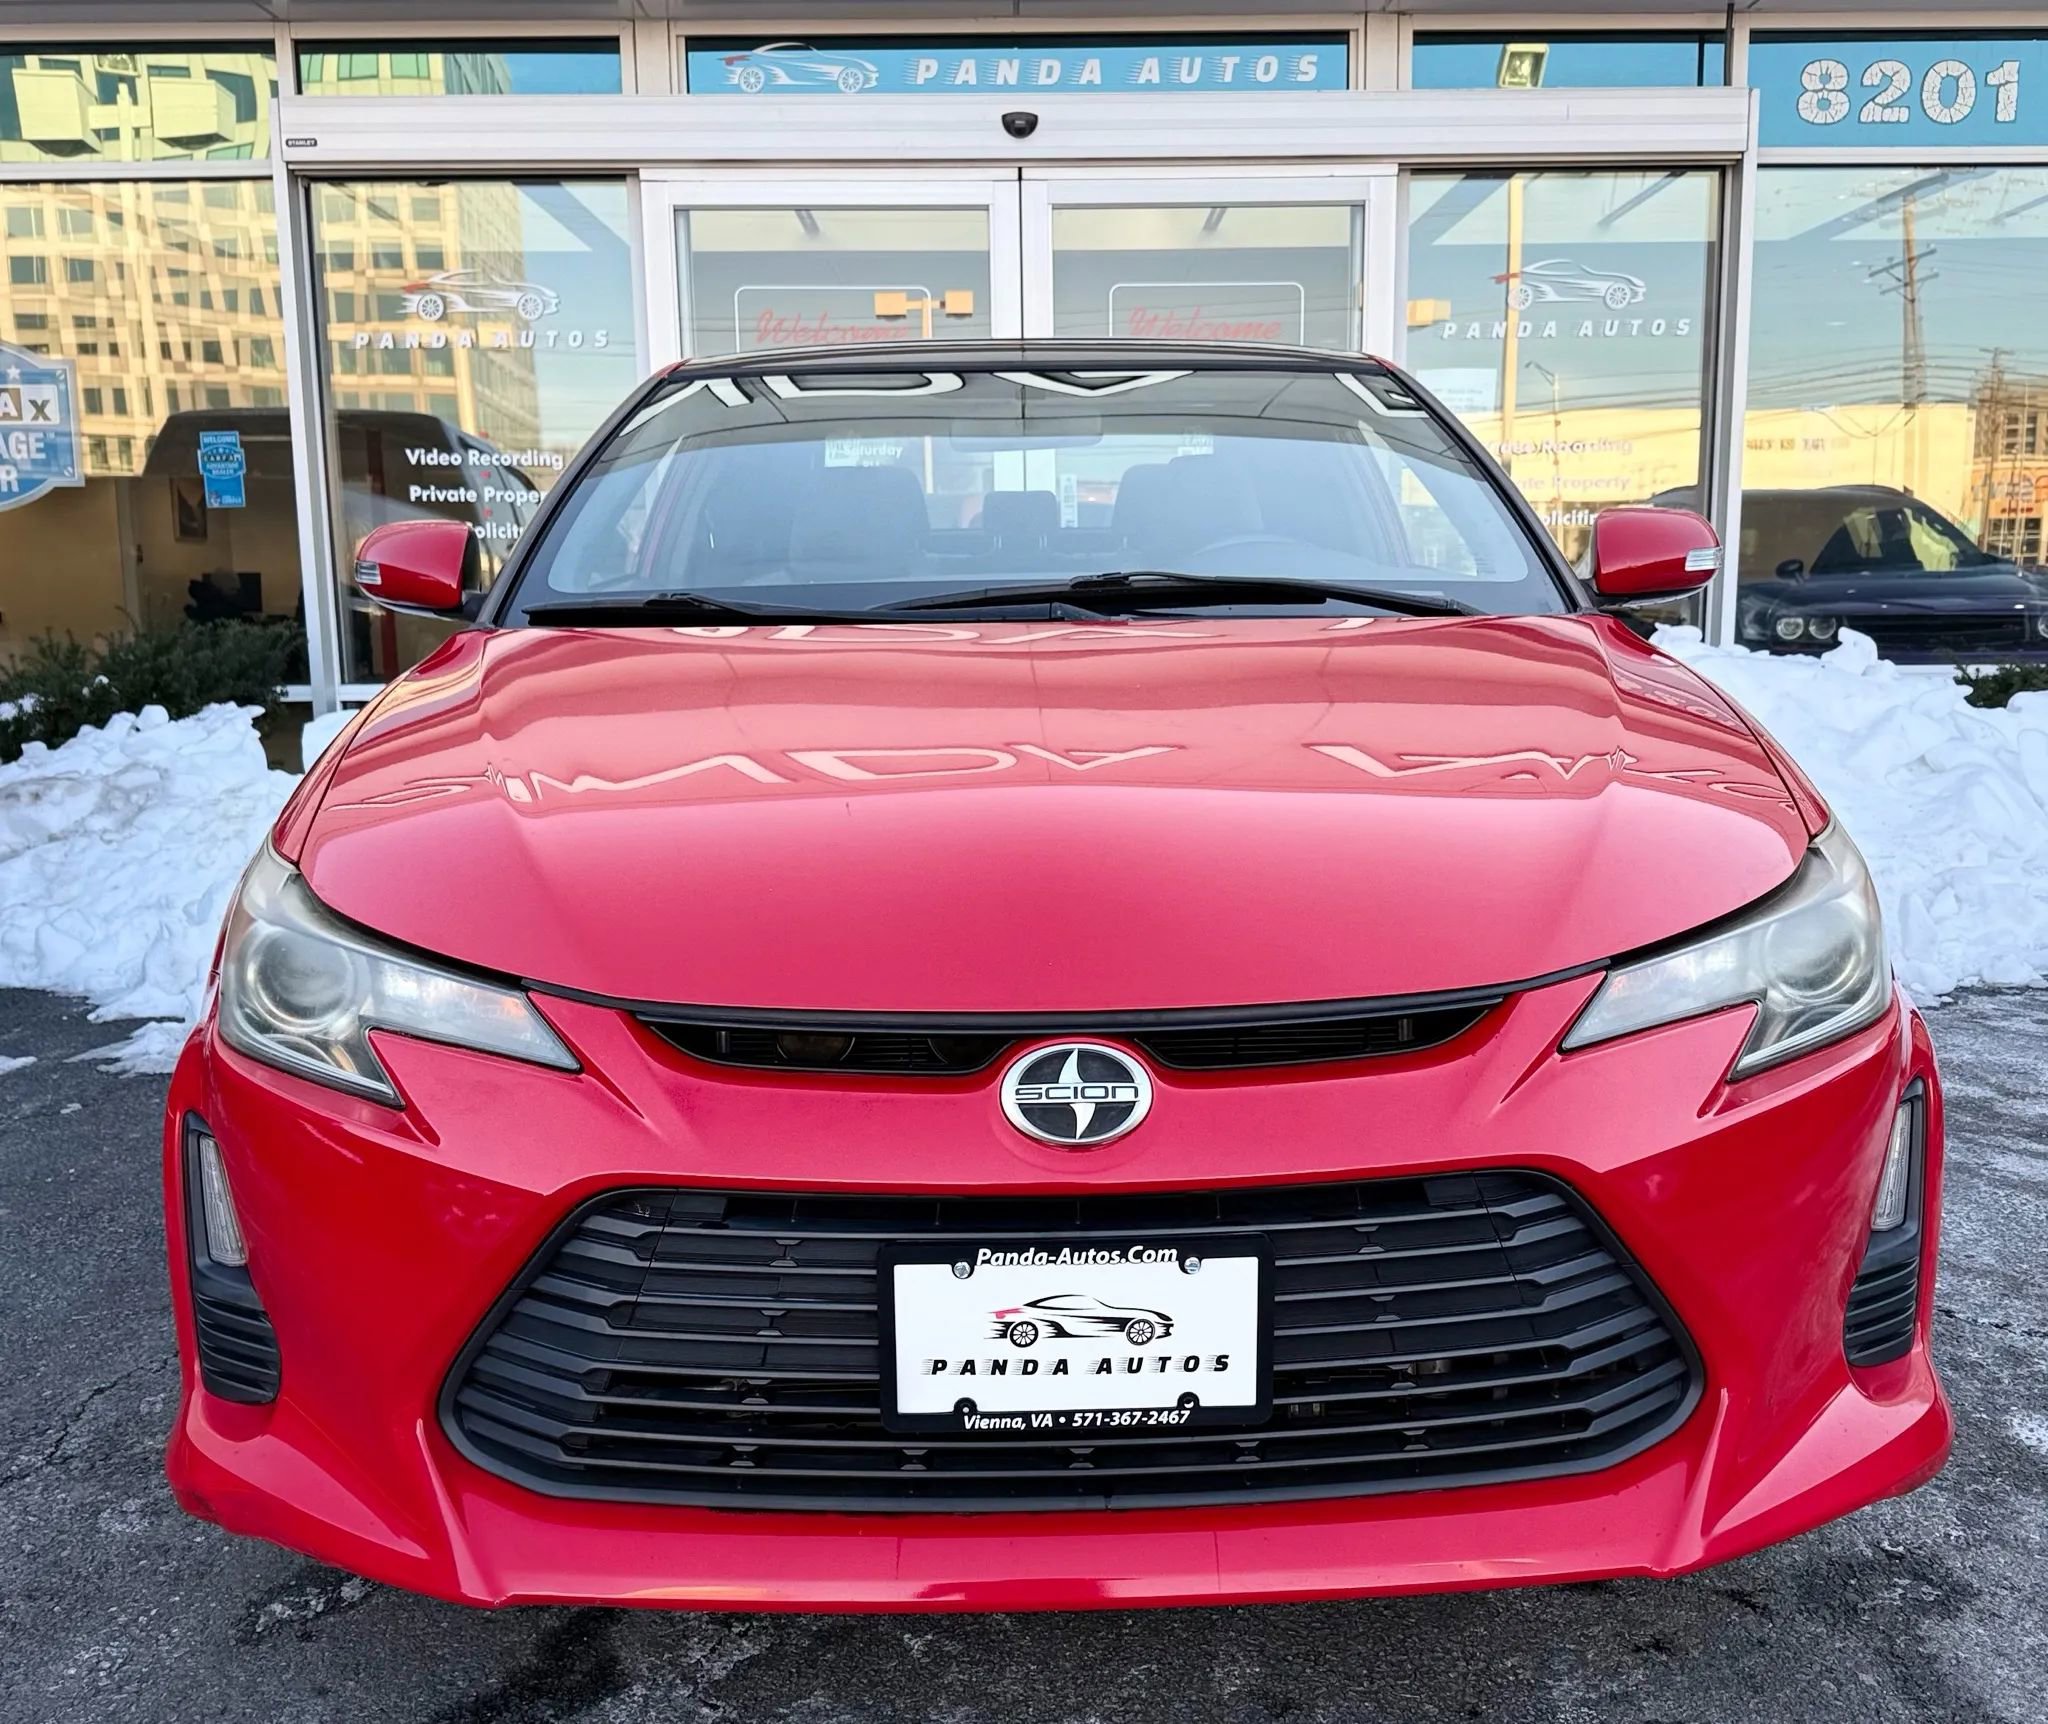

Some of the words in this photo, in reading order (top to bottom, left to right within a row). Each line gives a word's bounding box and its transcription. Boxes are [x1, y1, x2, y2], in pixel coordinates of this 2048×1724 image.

[908, 58, 1102, 86] PANDA
[1129, 55, 1319, 85] AUTOS
[1796, 58, 2022, 126] 8201
[1441, 320, 1557, 340] PANDA
[1578, 318, 1691, 338] AUTOS
[354, 331, 475, 350] PANDA
[494, 330, 609, 349] AUTOS
[405, 448, 463, 467] Video
[468, 448, 564, 469] Recording
[409, 485, 478, 503] Private
[1015, 1085, 1139, 1101] SCION
[975, 1246, 1178, 1267] Panda-Autos.Com
[924, 1357, 1069, 1376] PANDA
[1088, 1354, 1229, 1376] AUTOS
[963, 1414, 1027, 1430] Vienna,
[1031, 1413, 1053, 1428] VA
[1072, 1409, 1191, 1427] 571-367-2467
